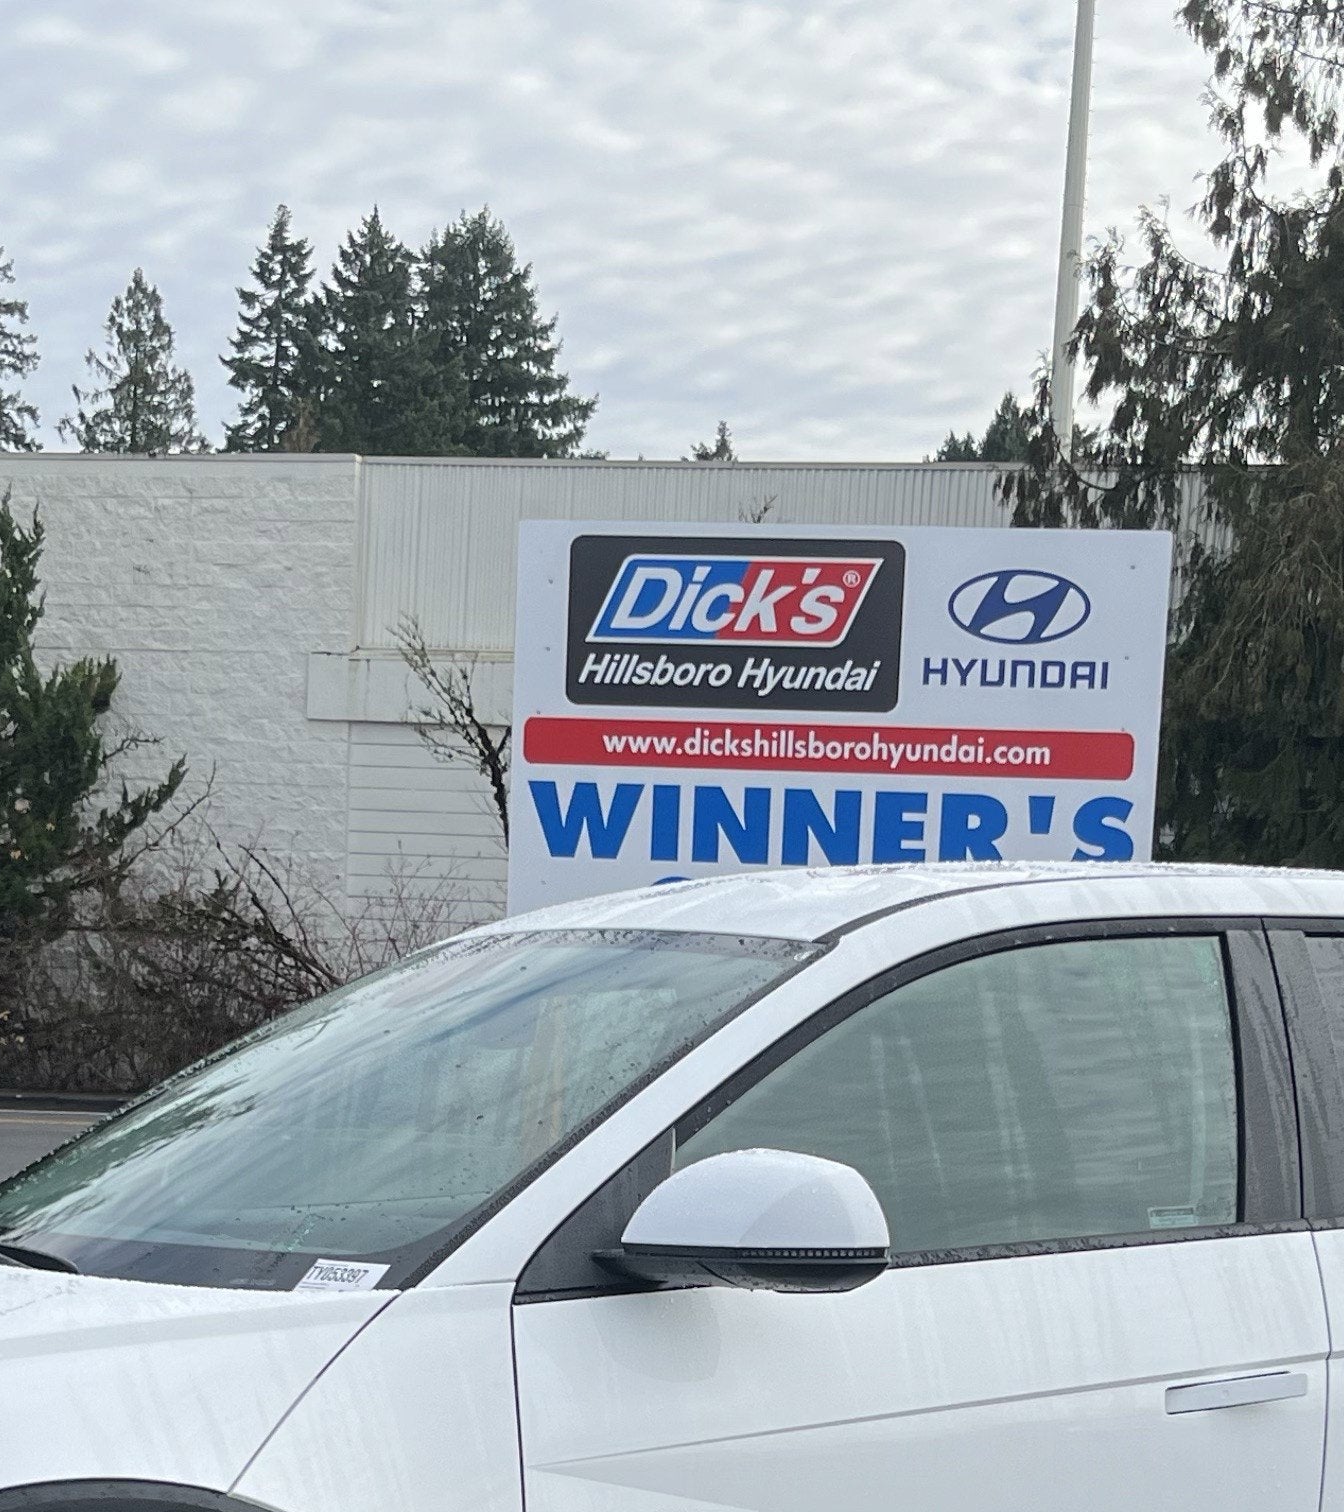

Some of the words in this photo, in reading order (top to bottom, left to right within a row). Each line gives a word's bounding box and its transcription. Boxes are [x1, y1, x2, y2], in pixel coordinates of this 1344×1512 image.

[609, 566, 845, 634] Dick's
[578, 653, 730, 687] Hillsboro
[738, 657, 880, 697] Hyundai
[922, 658, 1108, 690] HYUNDAI
[602, 728, 1051, 768] www.dickshillsborohyundai.com
[528, 781, 1135, 865] WINNER'S
